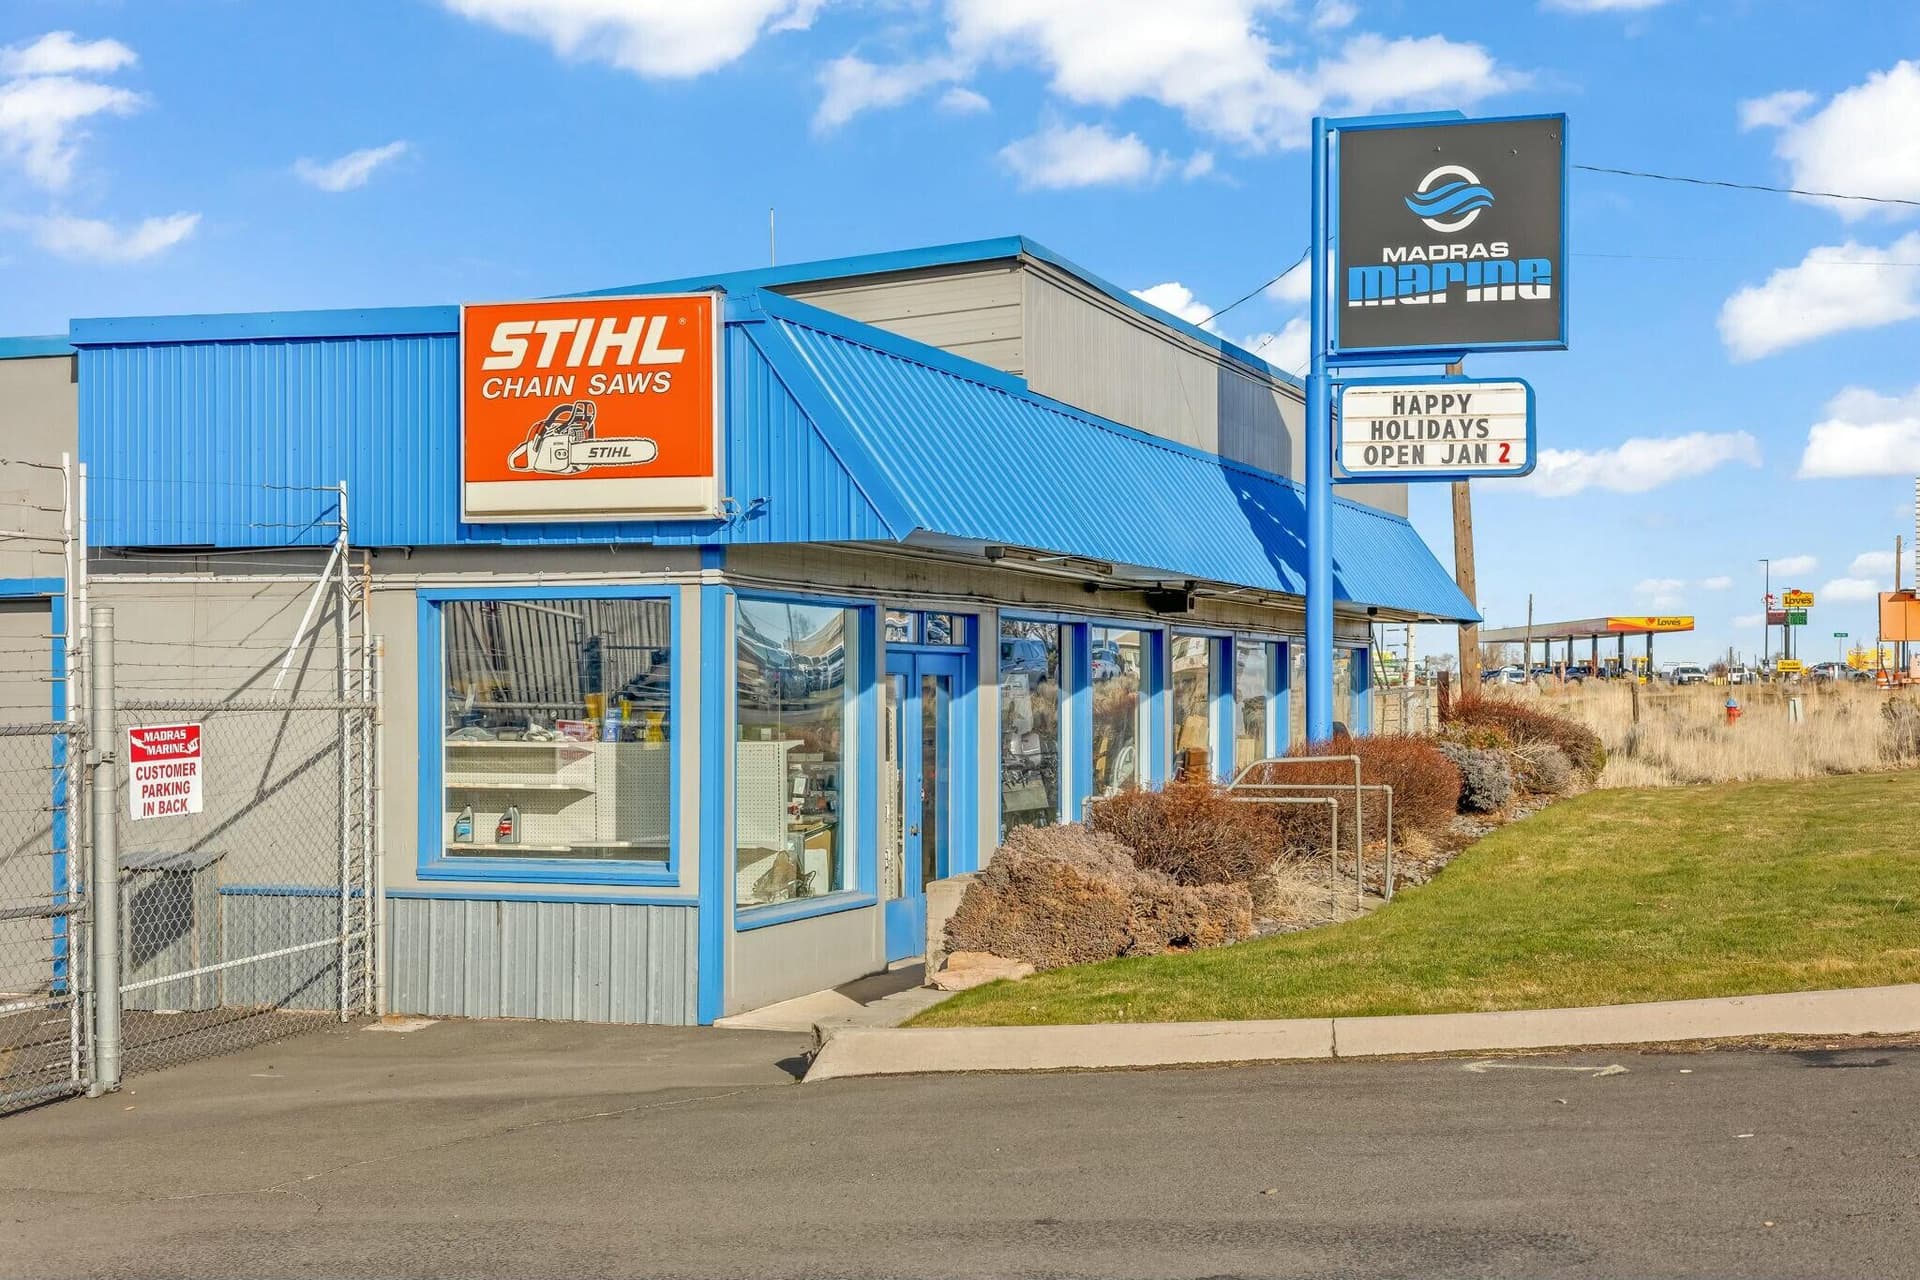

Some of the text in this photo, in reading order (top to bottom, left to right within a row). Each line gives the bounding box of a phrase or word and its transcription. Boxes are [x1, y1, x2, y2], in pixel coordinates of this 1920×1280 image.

[1382, 242, 1509, 263] MADRAS
[481, 315, 687, 371] STIHL
[482, 371, 672, 399] CHAIN SAWS
[1392, 393, 1472, 415] HAPPY
[1370, 418, 1490, 441] HOLIDAYS
[588, 446, 632, 459] STIHL
[1363, 442, 1511, 466] OPEN JAN 2
[143, 729, 187, 742] MADRAS
[146, 743, 186, 755] MARINE
[135, 762, 196, 781] CUSTOMER
[141, 780, 191, 799] PARKING
[143, 798, 188, 817] IN BACK
